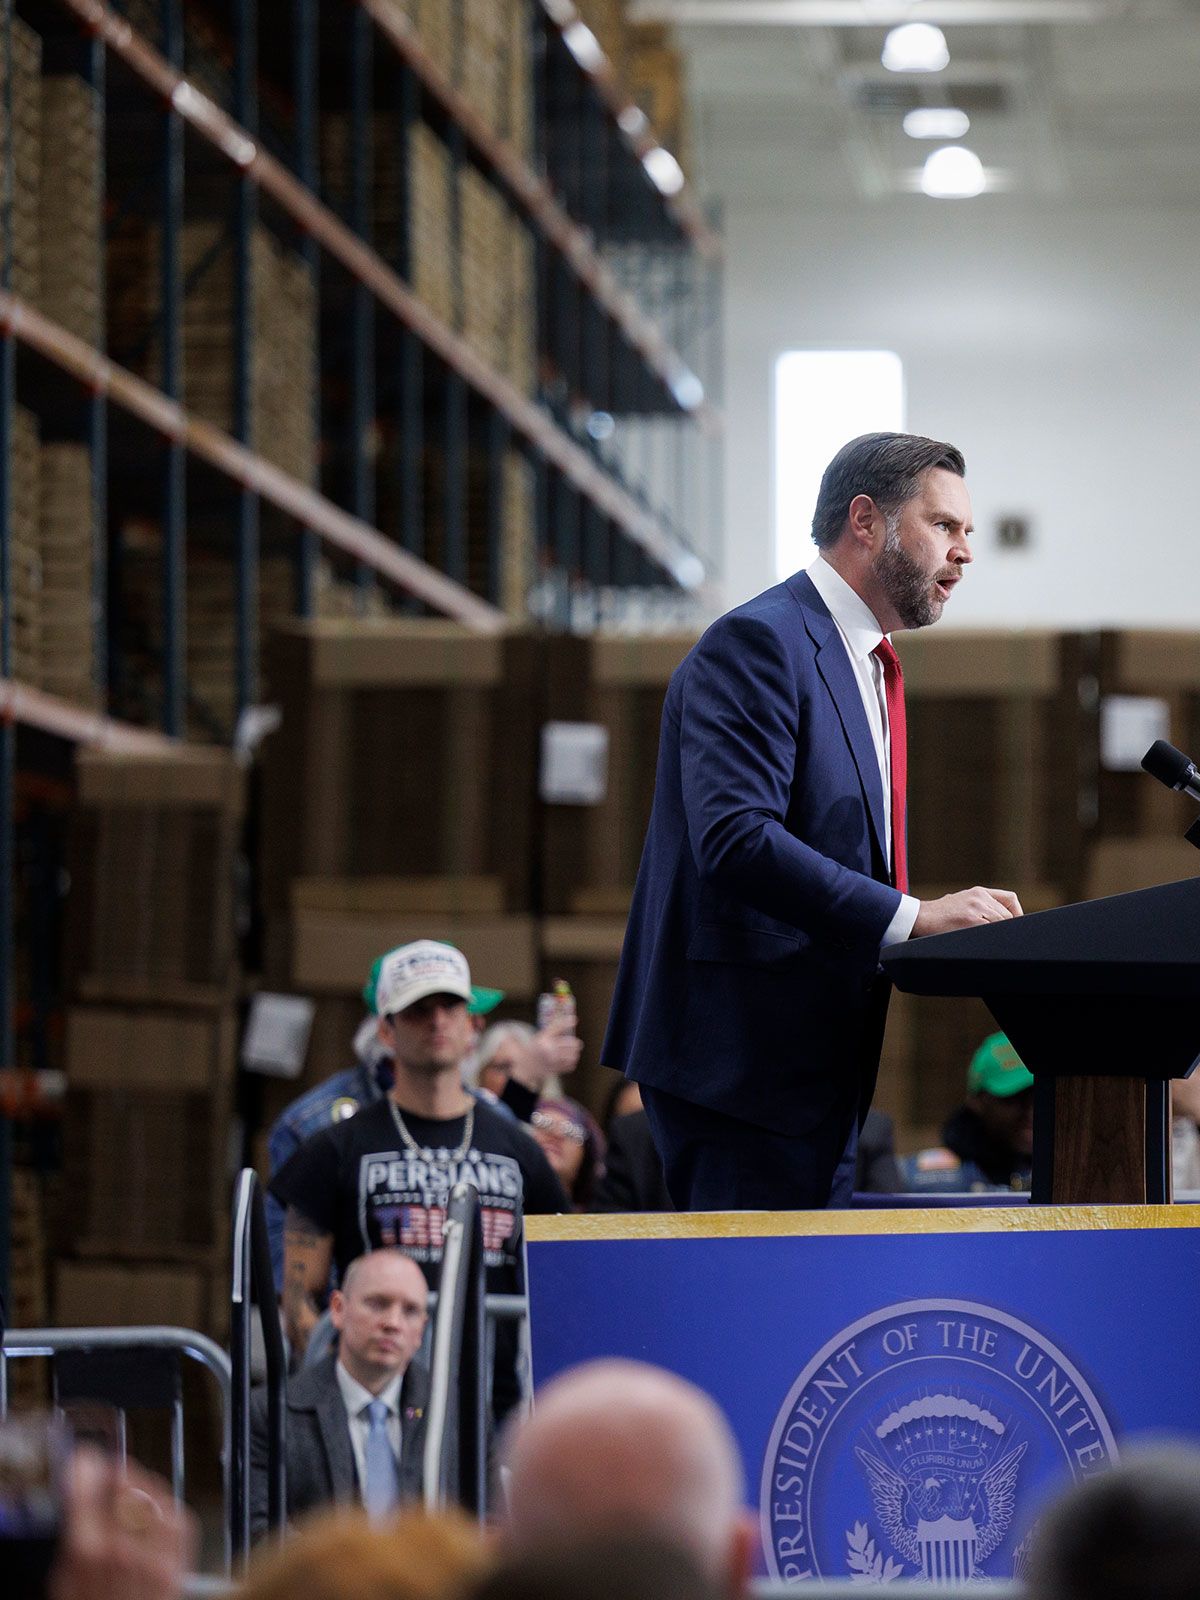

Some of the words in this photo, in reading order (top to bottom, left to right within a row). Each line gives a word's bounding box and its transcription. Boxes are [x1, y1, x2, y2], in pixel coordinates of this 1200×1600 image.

[367, 1159, 518, 1198] PERSIANS
[774, 1342, 865, 1585] PRESIDENT
[882, 1323, 919, 1355] OF
[936, 1320, 999, 1358] THE
[1014, 1342, 1106, 1479] UNITE
[902, 1463, 912, 1474] E
[910, 1454, 956, 1467] PLURIBUS
[957, 1457, 984, 1470] UNUM
